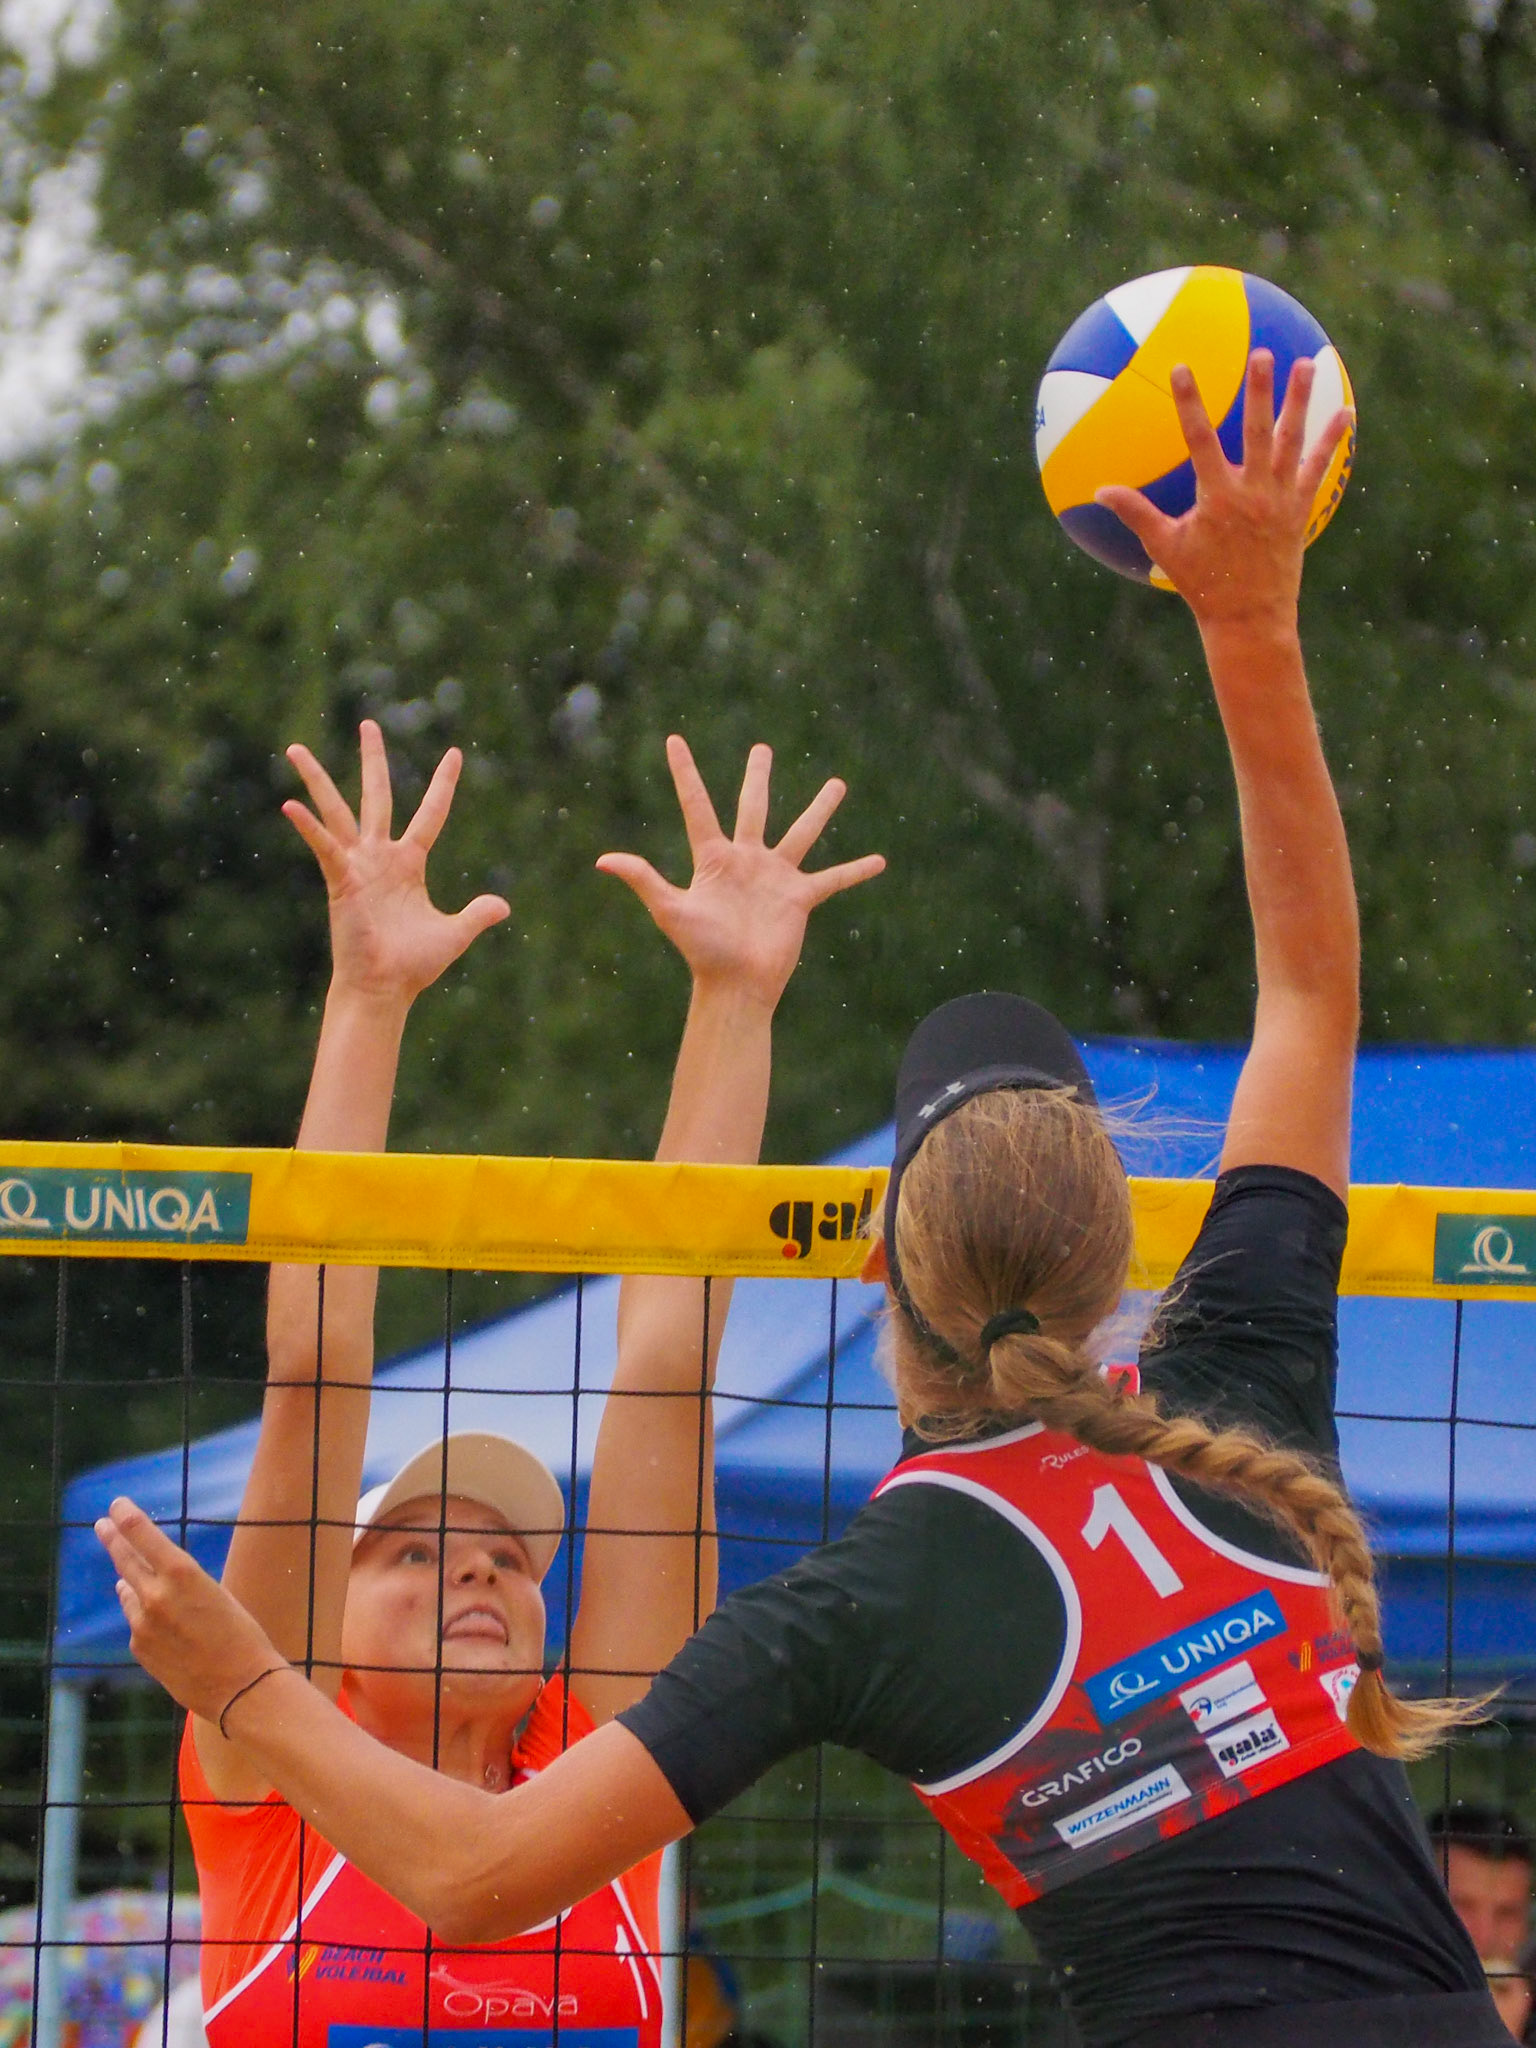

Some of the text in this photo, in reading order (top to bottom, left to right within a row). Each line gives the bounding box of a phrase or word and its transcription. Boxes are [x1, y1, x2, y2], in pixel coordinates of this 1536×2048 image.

[65, 1186, 221, 1232] UNIQA
[769, 1187, 874, 1260] gal
[1081, 1482, 1185, 1599] 1
[1160, 1607, 1277, 1674] UNIQA
[1021, 1737, 1142, 1808] GRAFICO
[1218, 1726, 1278, 1767] gala
[1066, 1776, 1171, 1835] WITZENMANN
[443, 1990, 579, 2025] Opava
